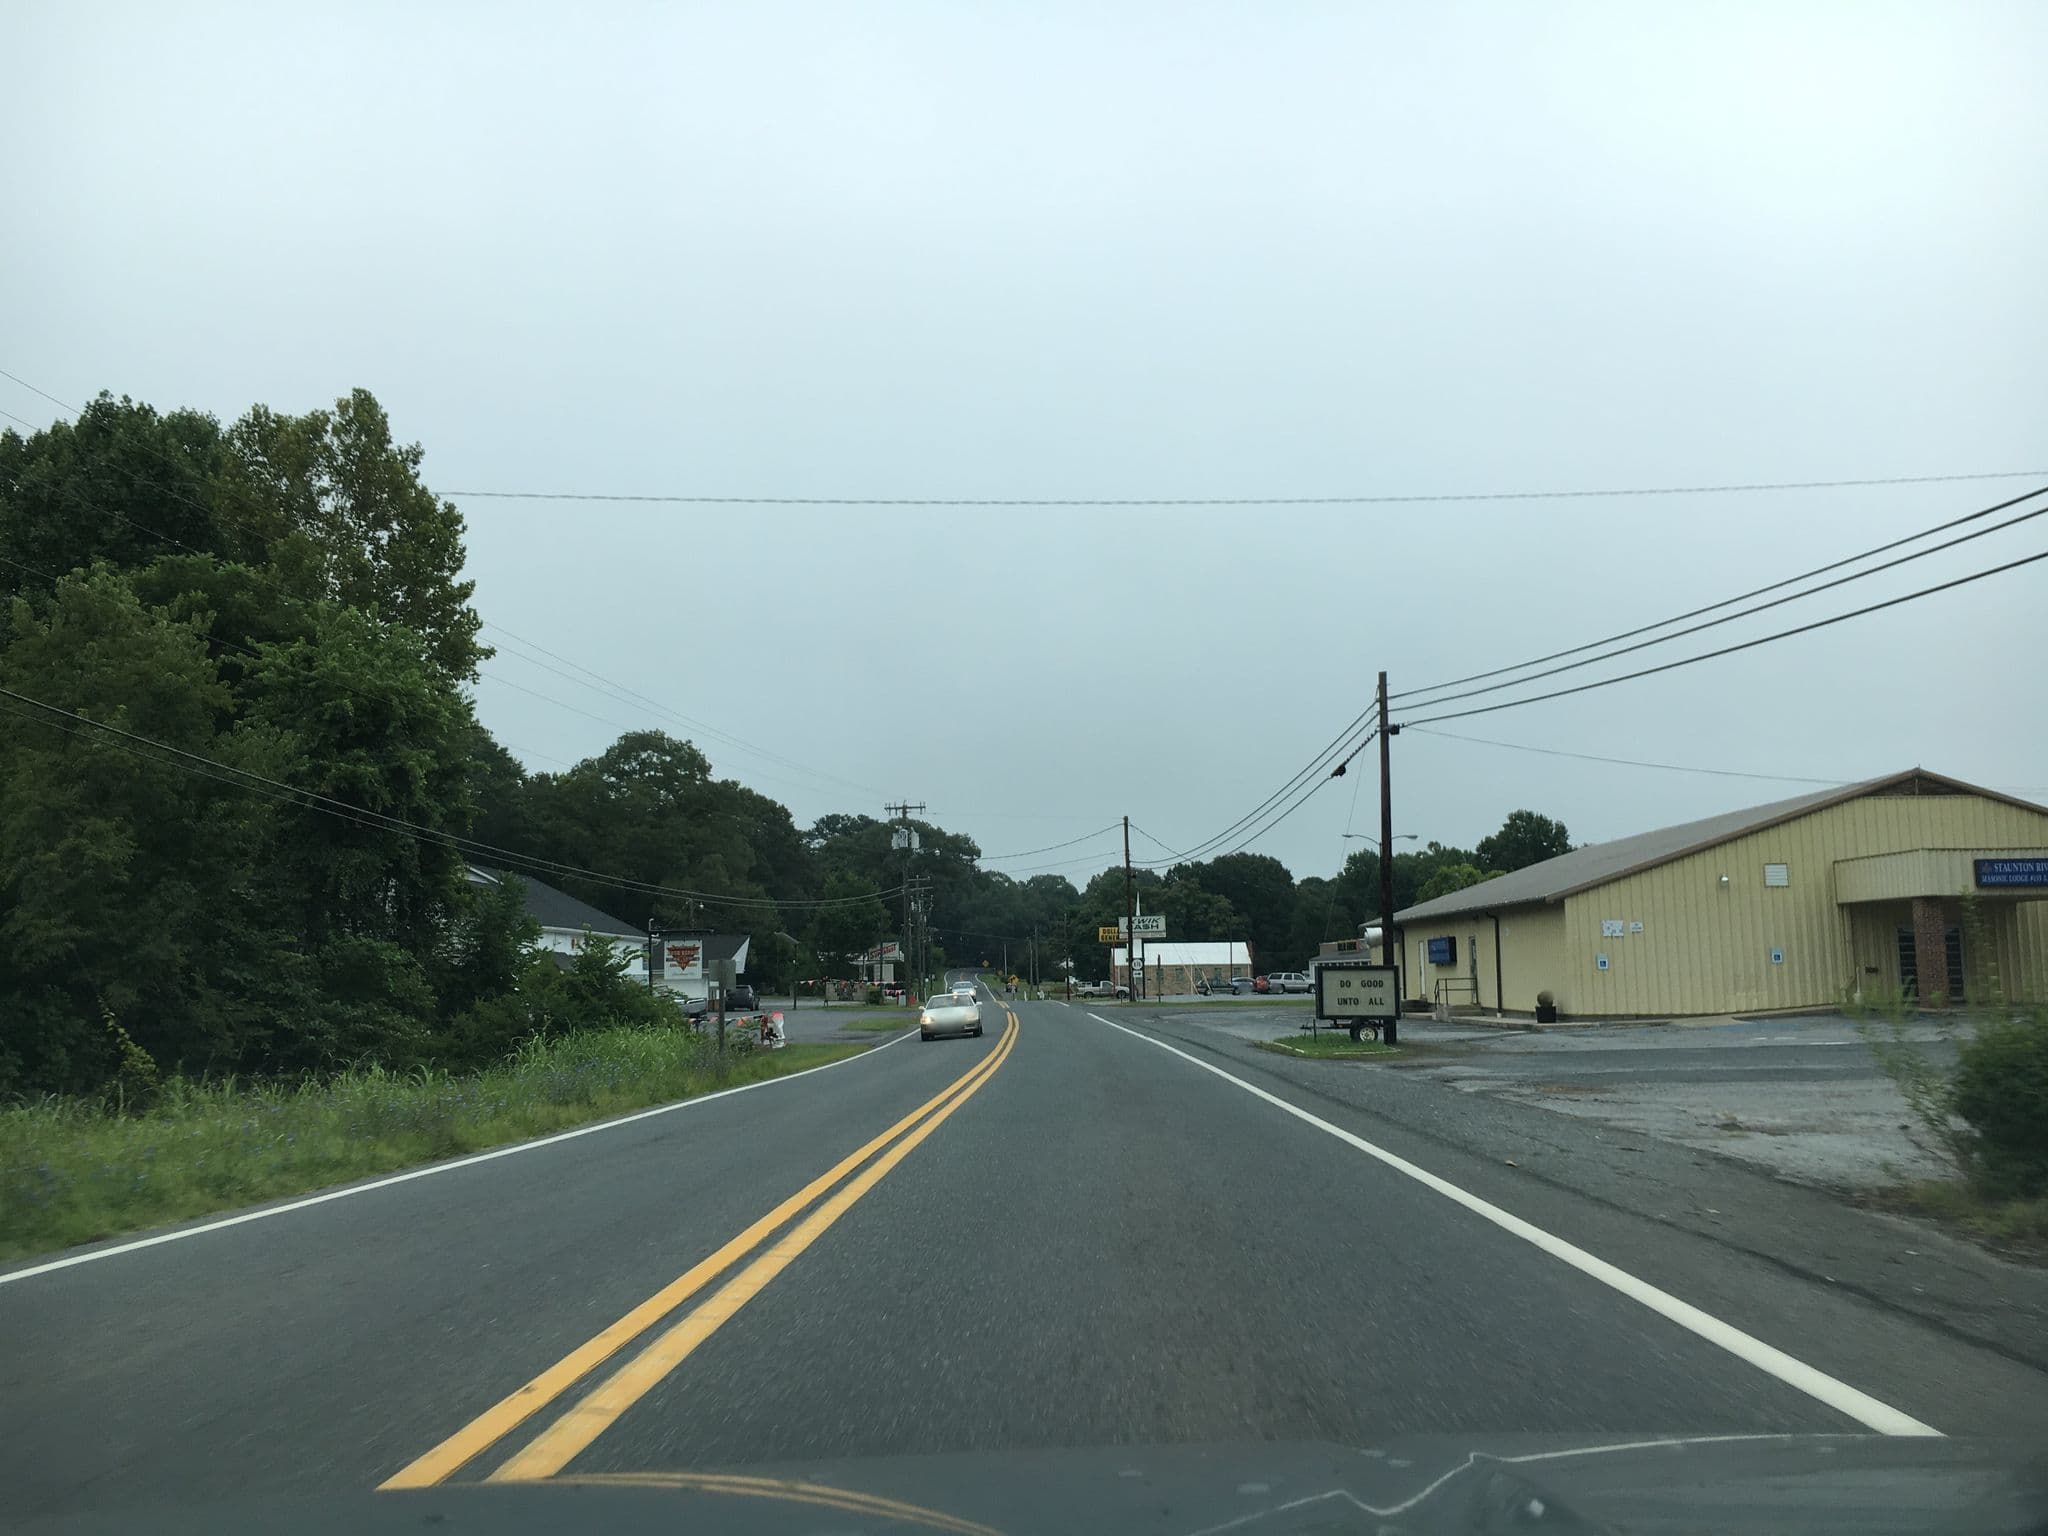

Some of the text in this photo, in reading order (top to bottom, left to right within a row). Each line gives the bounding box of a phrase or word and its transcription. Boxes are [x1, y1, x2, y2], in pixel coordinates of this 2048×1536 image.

[1994, 862, 2034, 872] STAUNTON
[2009, 874, 2028, 882] LODGE
[1339, 979, 1384, 989] DO GOOD
[1337, 997, 1385, 1006] UNTO ALL
